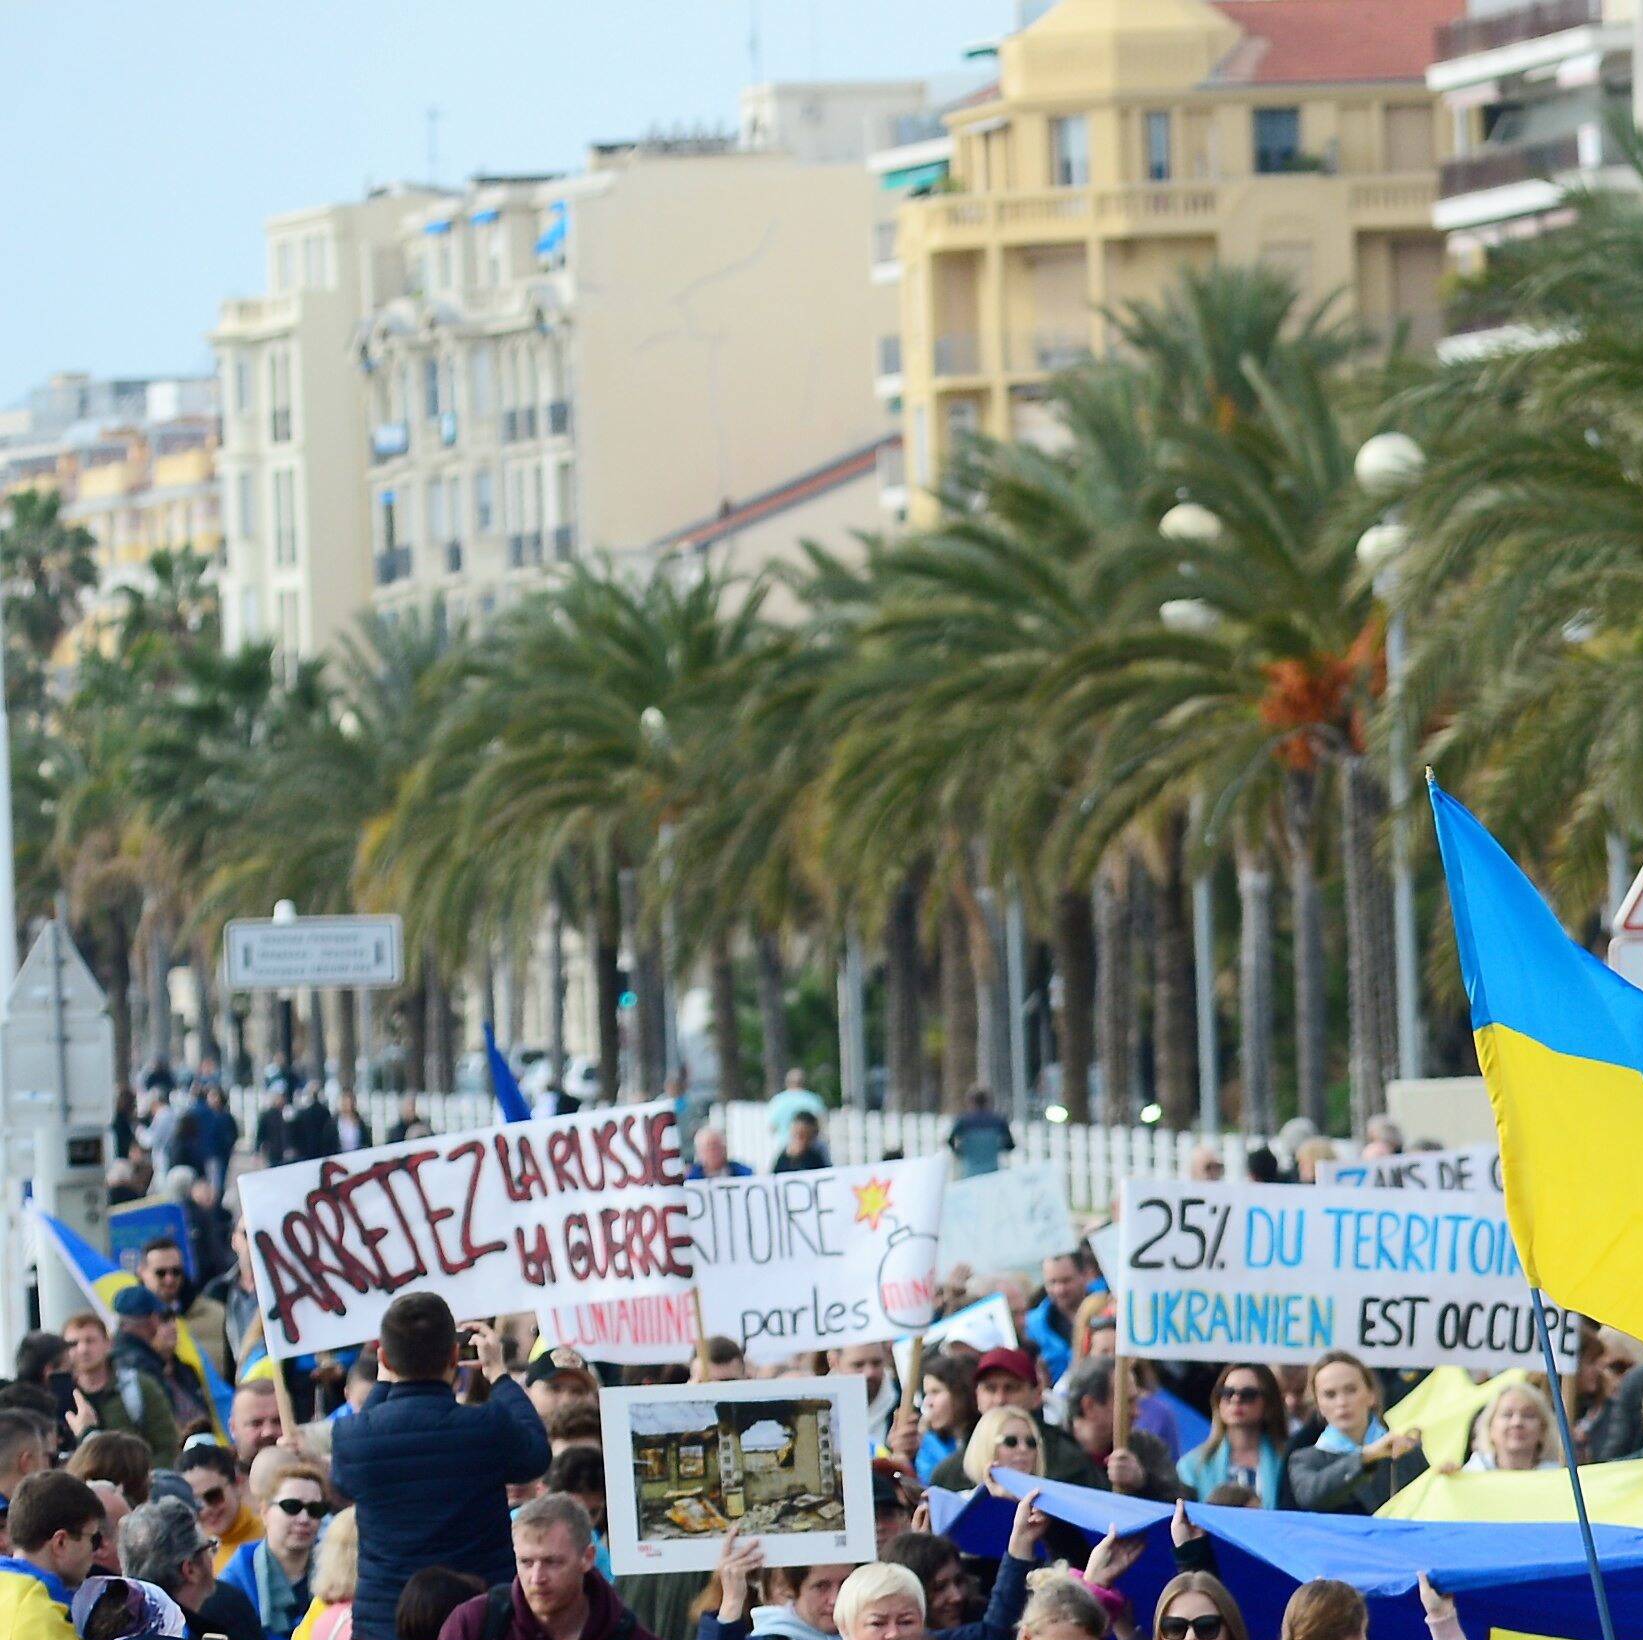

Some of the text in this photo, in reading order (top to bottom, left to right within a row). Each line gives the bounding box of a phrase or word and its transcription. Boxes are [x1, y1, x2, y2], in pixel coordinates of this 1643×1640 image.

[255, 1111, 686, 1344] ARRÊTEZ LA RUSSIE
[563, 1205, 693, 1283] GUERRE
[689, 1176, 843, 1265] RITOIRE
[1129, 1198, 1231, 1270] 25%
[1245, 1207, 1305, 1269] DU
[1324, 1207, 1526, 1275] TERRITOI
[1128, 1291, 1337, 1348] UKRAINIEN
[1359, 1297, 1430, 1347] EST
